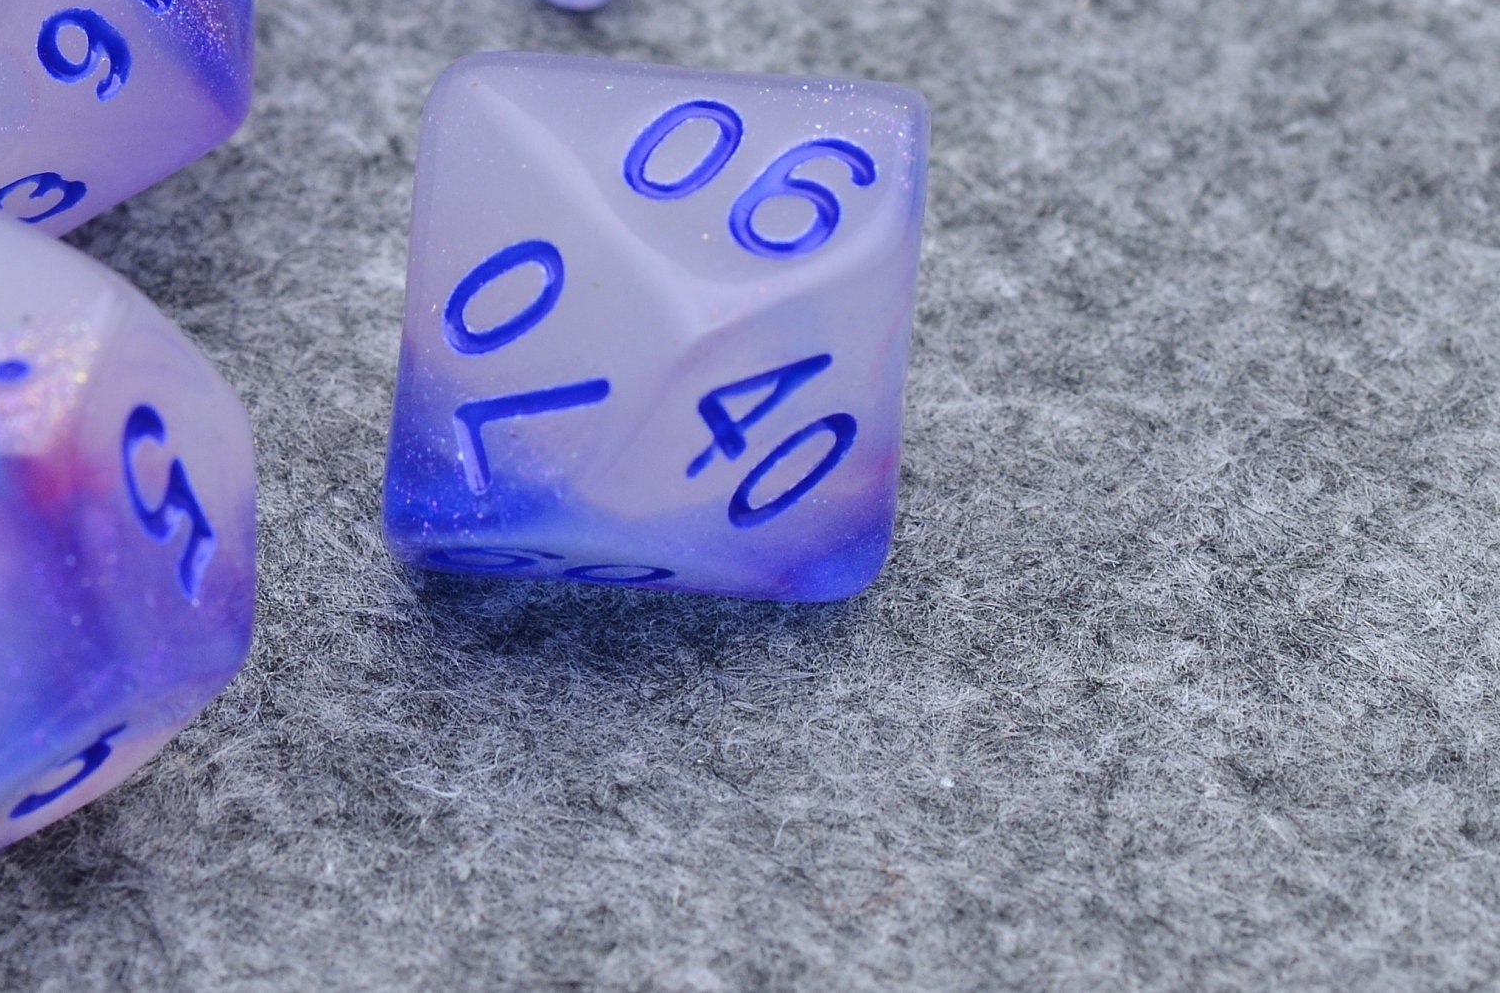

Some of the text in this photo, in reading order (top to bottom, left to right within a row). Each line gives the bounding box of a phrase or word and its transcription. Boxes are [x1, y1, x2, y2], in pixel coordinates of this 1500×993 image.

[443, 239, 610, 496] 70
[686, 353, 857, 529] 40
[122, 404, 216, 602] 5
